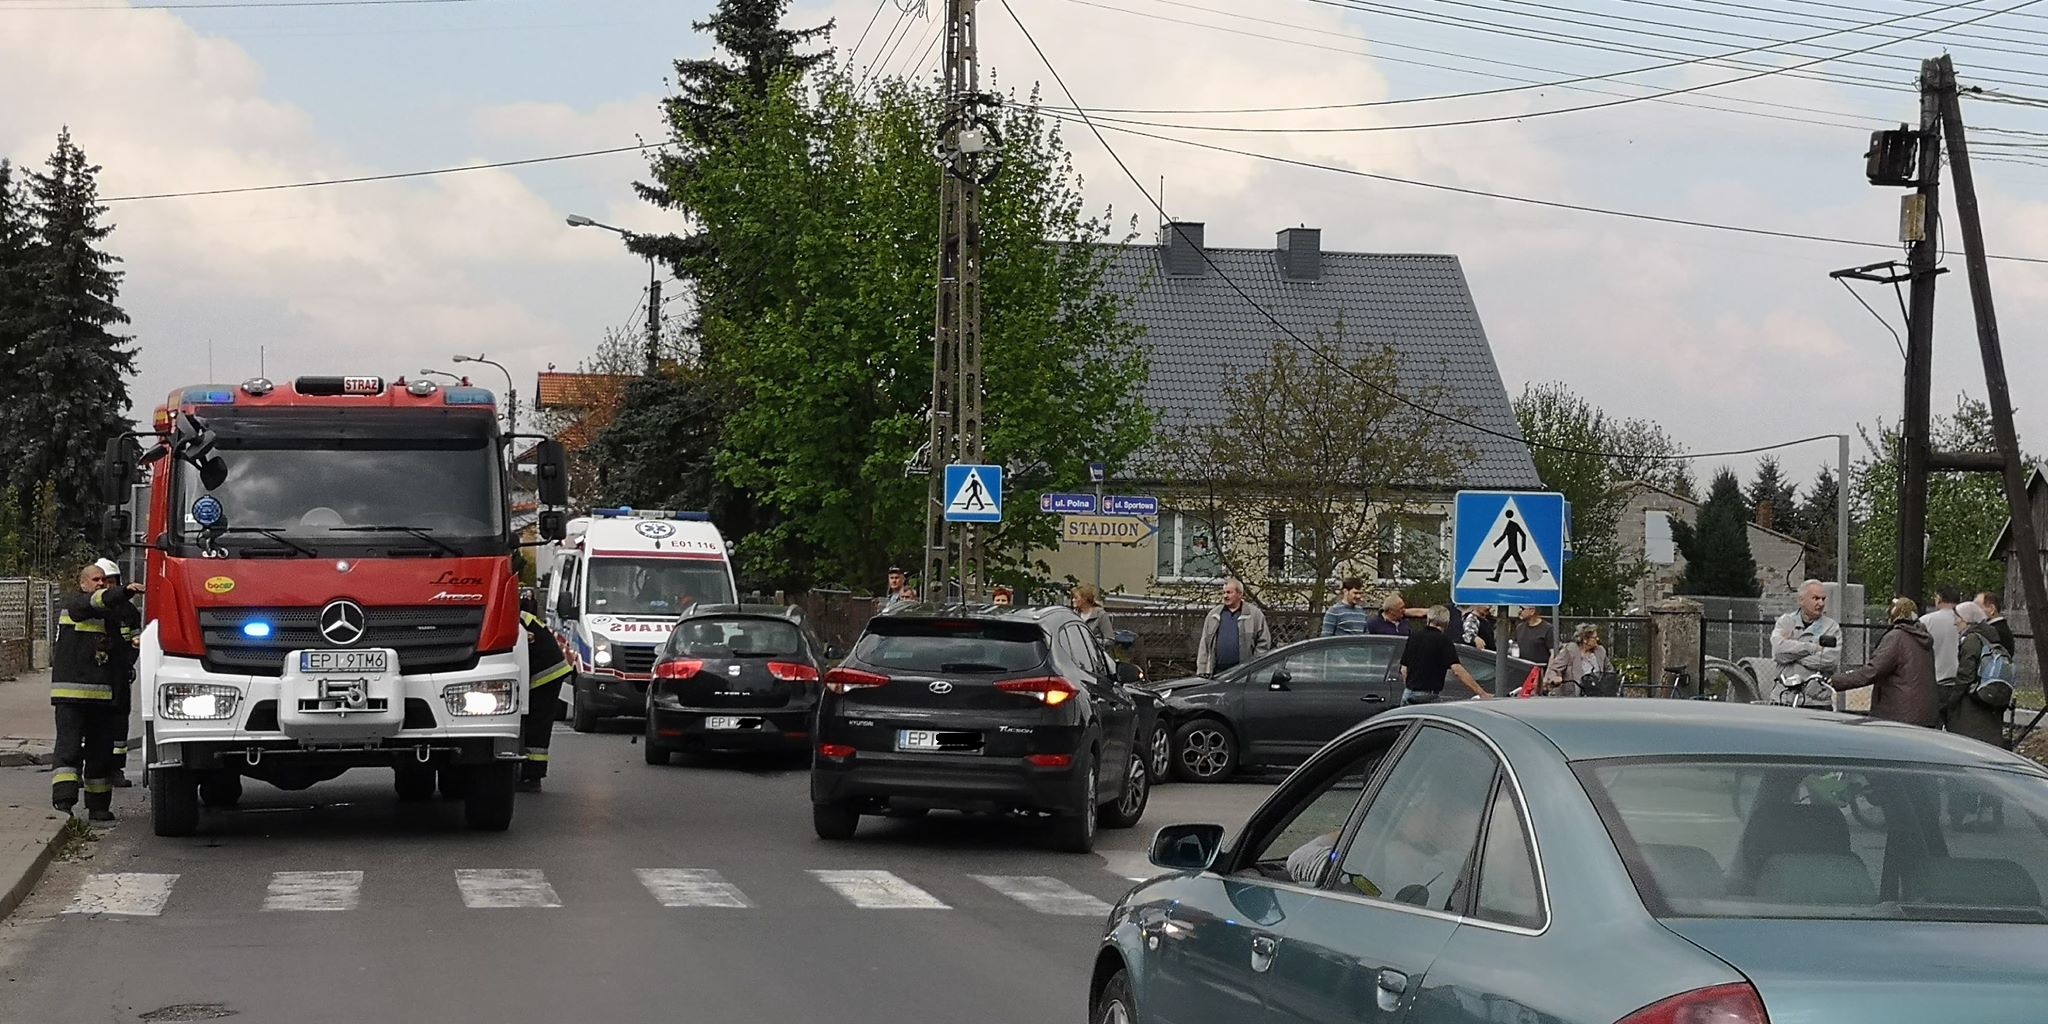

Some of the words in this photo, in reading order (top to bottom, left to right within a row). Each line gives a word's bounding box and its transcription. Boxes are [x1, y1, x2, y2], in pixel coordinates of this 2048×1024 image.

[1067, 500, 1089, 508] Polna
[1124, 501, 1153, 510] Sportowa
[1069, 522, 1139, 536] STADION
[311, 654, 338, 668] EPI
[347, 654, 383, 668] 9TM6
[908, 732, 935, 746] EPI
